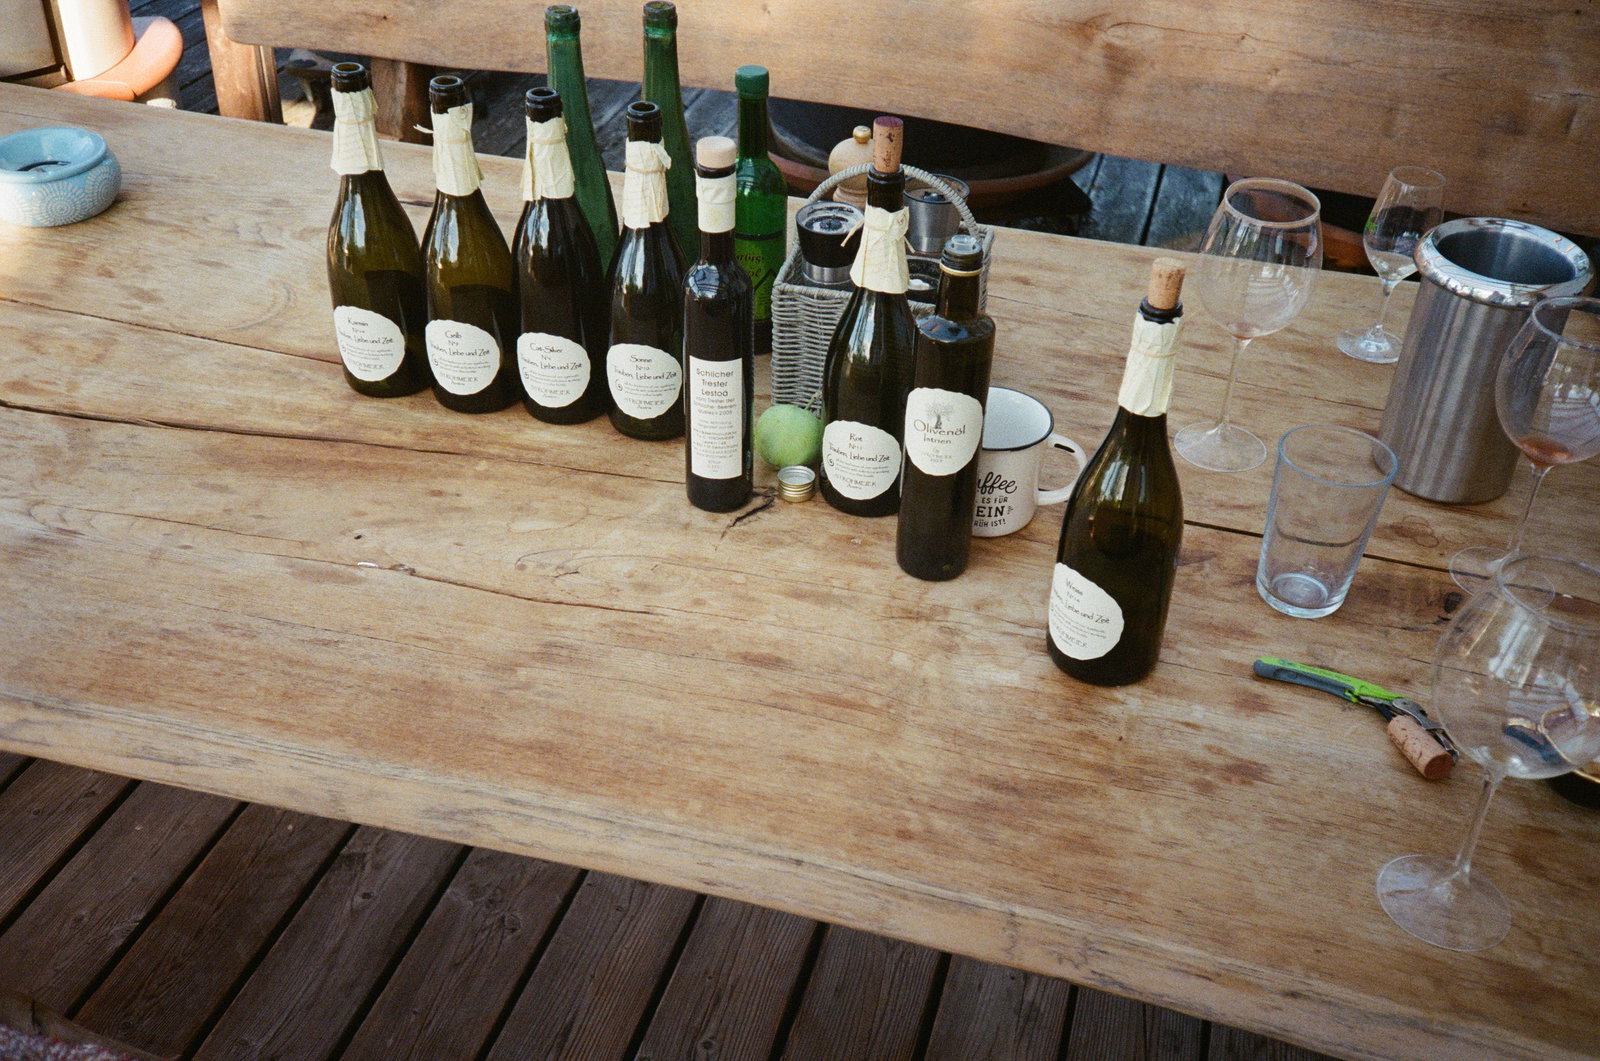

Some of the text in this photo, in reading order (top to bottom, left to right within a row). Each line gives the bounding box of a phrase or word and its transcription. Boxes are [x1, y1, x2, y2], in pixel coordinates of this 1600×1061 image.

[630, 354, 653, 363] Sonne
[696, 367, 735, 378] Schilcher
[702, 379, 728, 388] Trester
[913, 418, 966, 436] Olivenöl
[977, 471, 1018, 495] ffee
[981, 495, 1009, 504] ES FÜR
[975, 505, 1006, 518] EIN
[973, 518, 1007, 528] RÜH IST!
